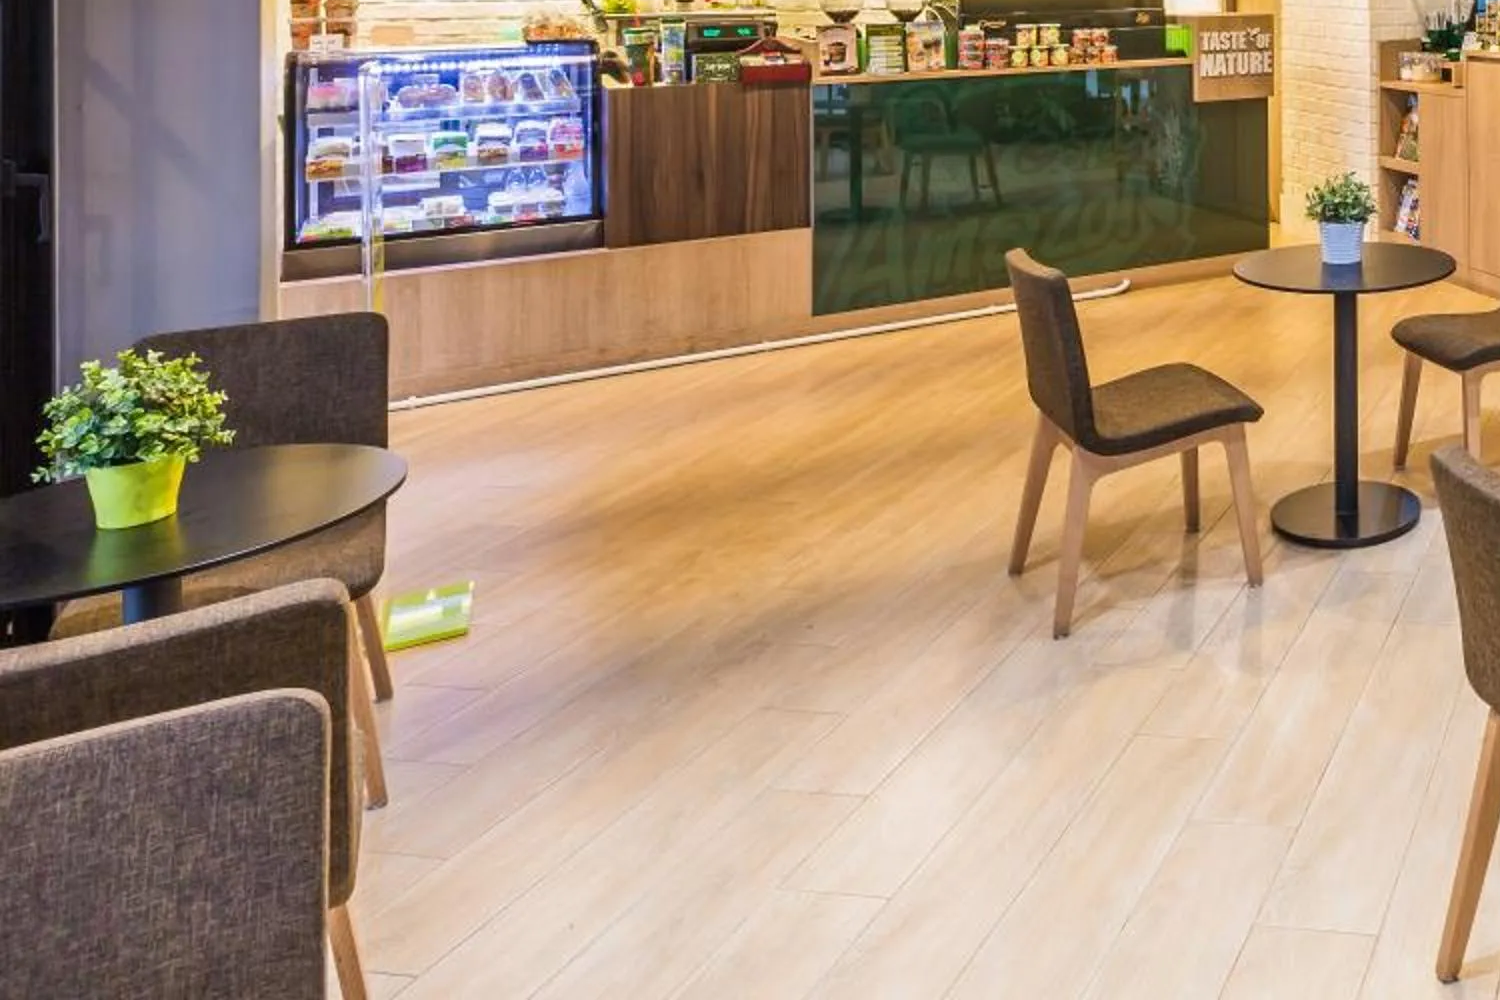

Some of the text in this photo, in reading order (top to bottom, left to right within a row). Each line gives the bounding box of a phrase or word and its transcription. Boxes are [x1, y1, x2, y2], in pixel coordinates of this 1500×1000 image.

[1200, 31, 1272, 50] TASTE OF
[1200, 51, 1273, 77] NATURE
